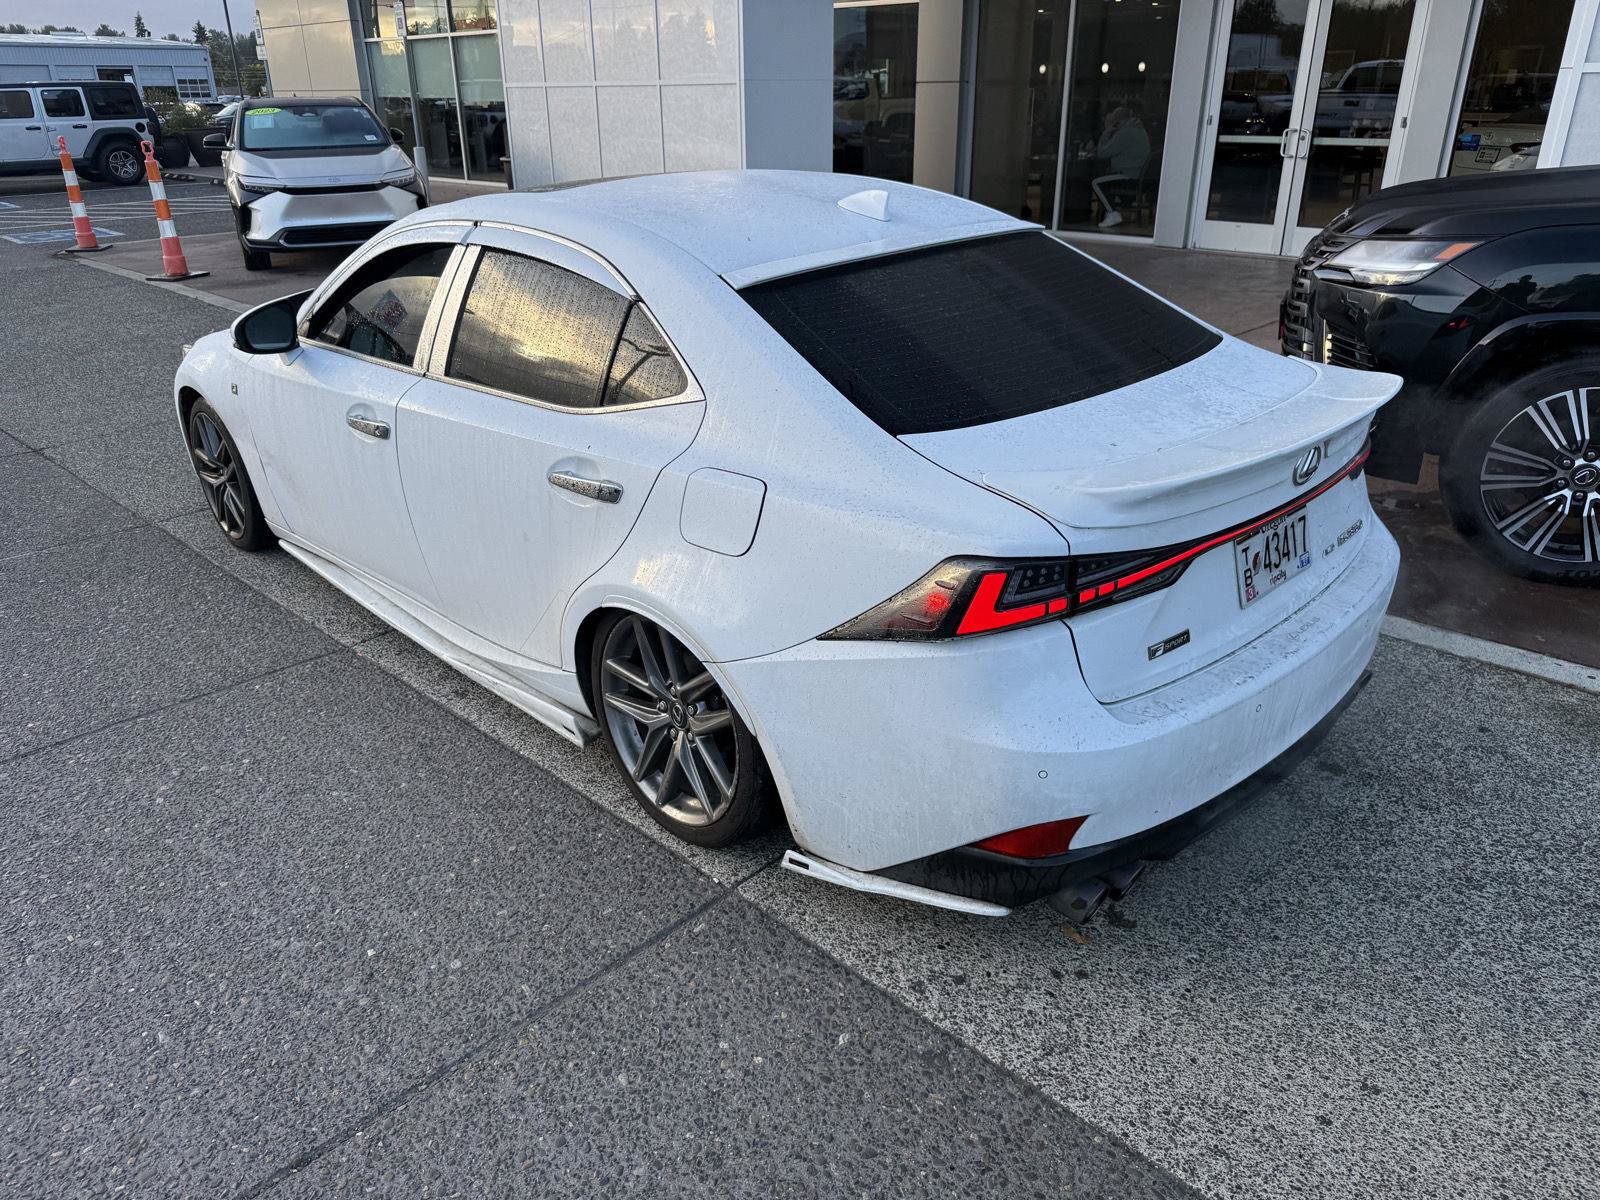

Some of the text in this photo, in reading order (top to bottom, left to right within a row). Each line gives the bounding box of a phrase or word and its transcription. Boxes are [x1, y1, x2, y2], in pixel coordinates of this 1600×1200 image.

[1263, 514, 1306, 573] 43417
[1248, 588, 1254, 599] 3
[1165, 634, 1188, 650] SPORT
